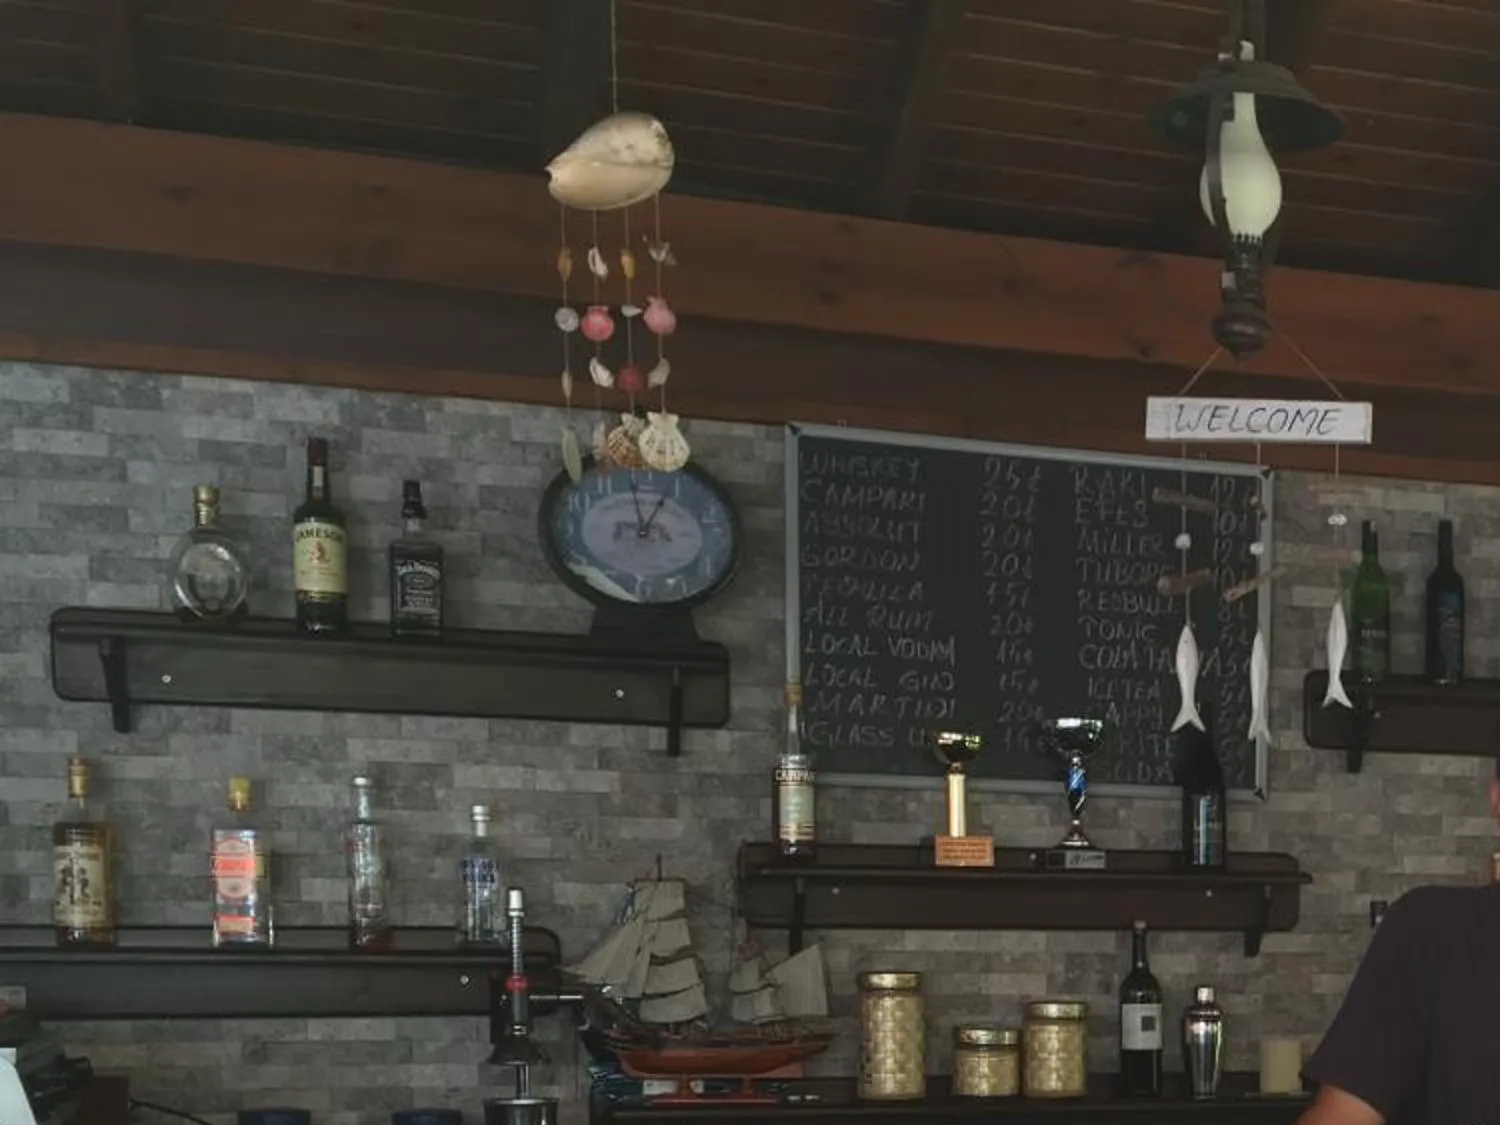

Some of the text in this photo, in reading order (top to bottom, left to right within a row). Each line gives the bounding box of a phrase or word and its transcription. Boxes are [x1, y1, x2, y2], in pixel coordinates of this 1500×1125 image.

[1173, 403, 1343, 437] WELCOME
[803, 478, 926, 513] CAMPARI
[1073, 464, 1146, 502] RAKI
[1075, 498, 1149, 528] EFES
[804, 629, 880, 658] LOCAL
[1077, 614, 1157, 643] TONIC
[804, 661, 880, 688] LOCAL
[1147, 646, 1222, 679] FAA
[1105, 700, 1164, 731] APPY
[808, 720, 897, 750] GLASS
